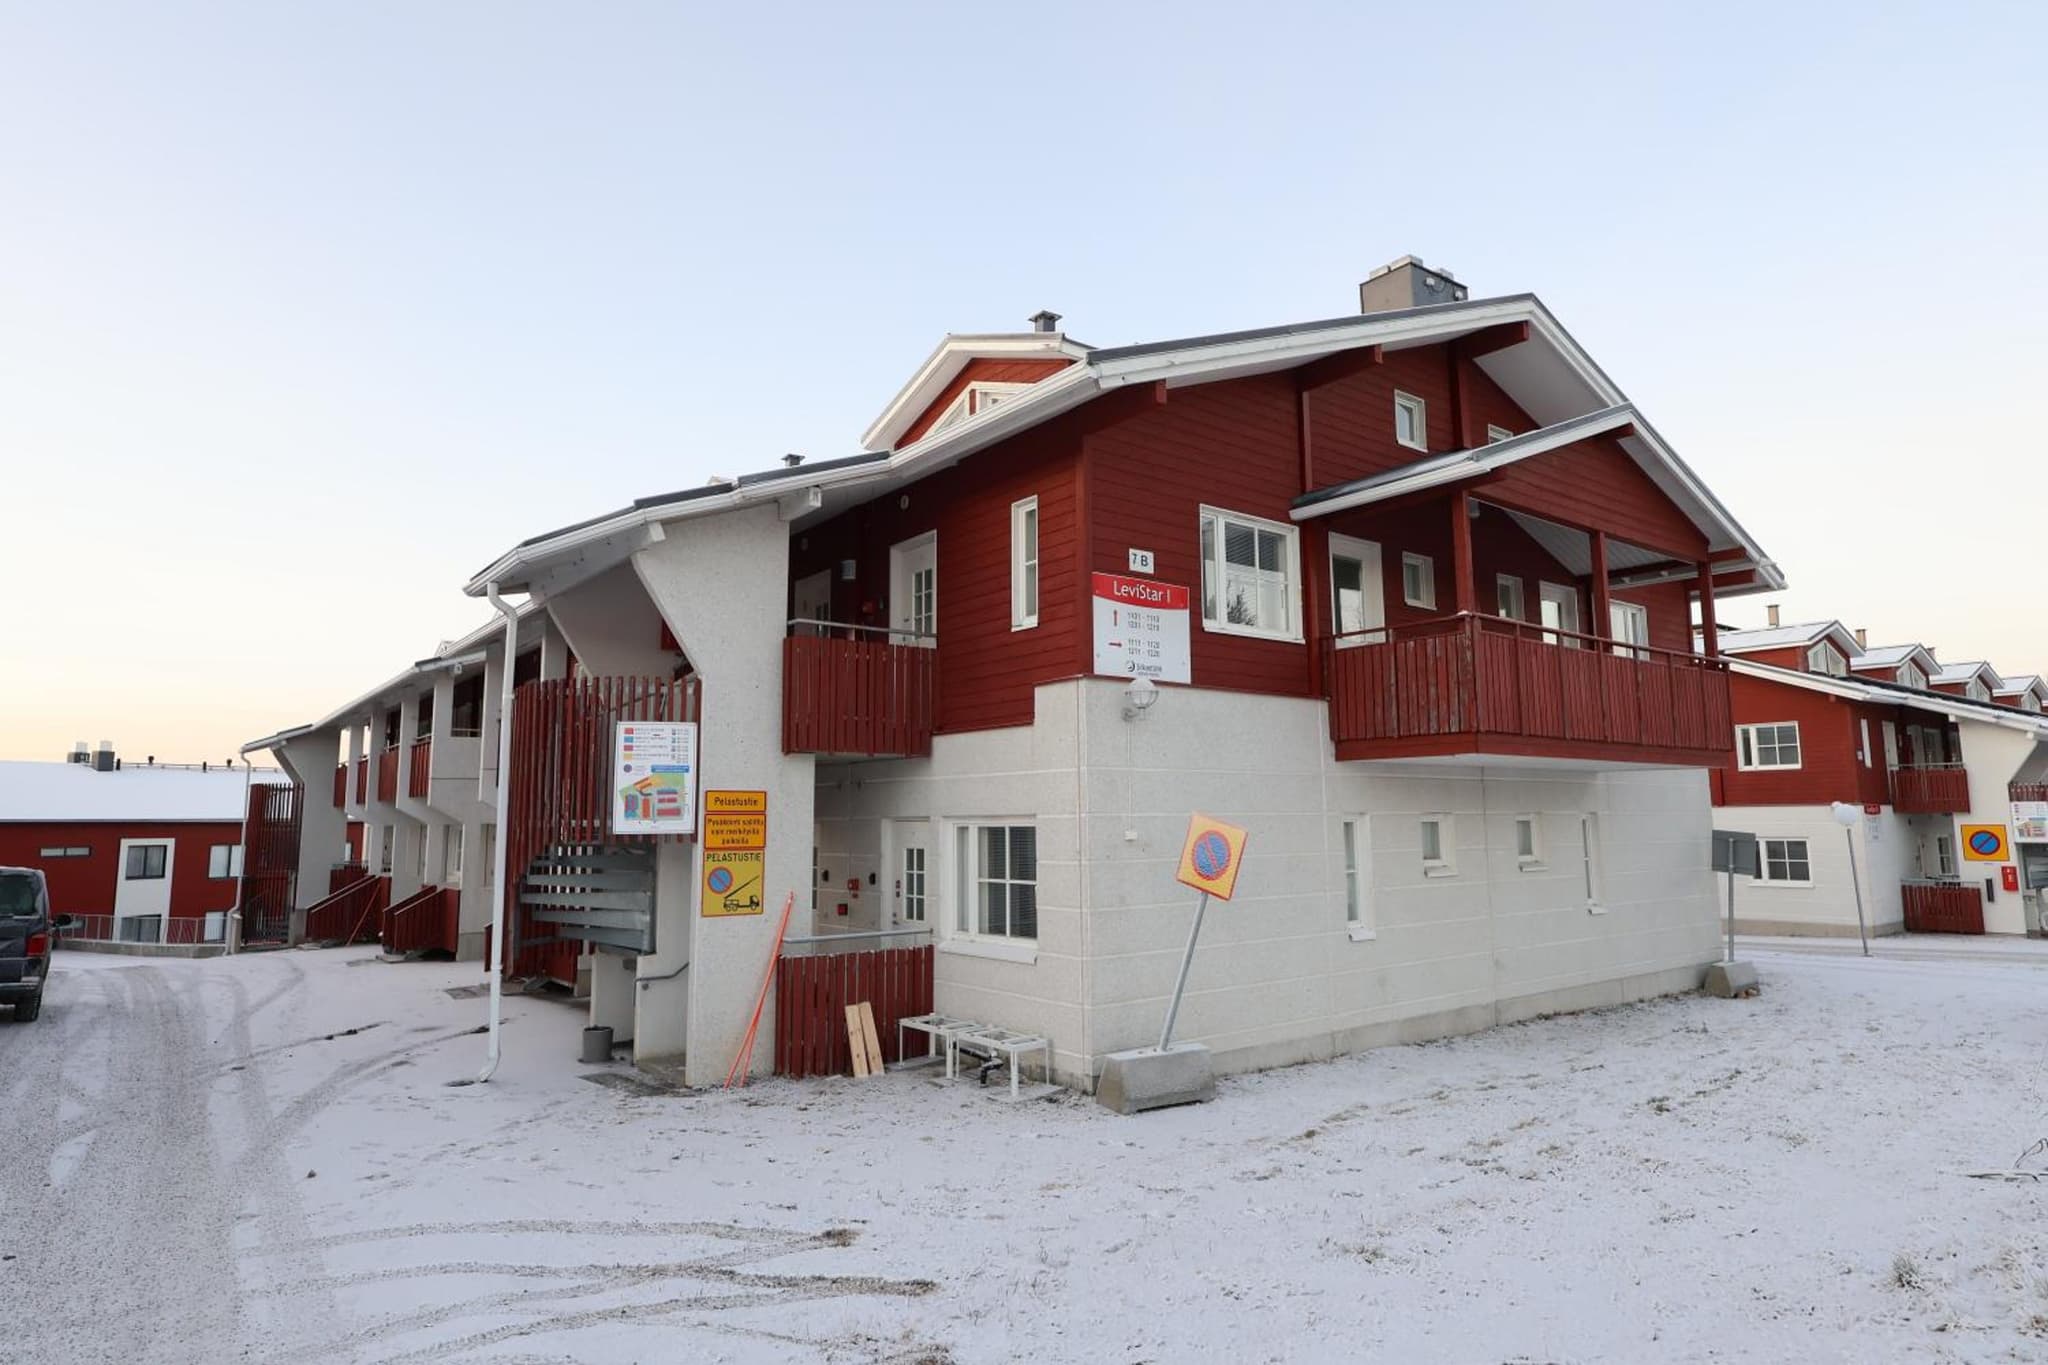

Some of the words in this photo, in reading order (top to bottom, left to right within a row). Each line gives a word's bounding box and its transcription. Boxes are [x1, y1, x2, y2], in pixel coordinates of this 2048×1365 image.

[1132, 553, 1138, 565] 7
[1140, 555, 1149, 567] B
[1113, 580, 1164, 601] LeviStar
[714, 796, 758, 806] Pelastustie
[706, 852, 761, 862] PELASTUSTIE
